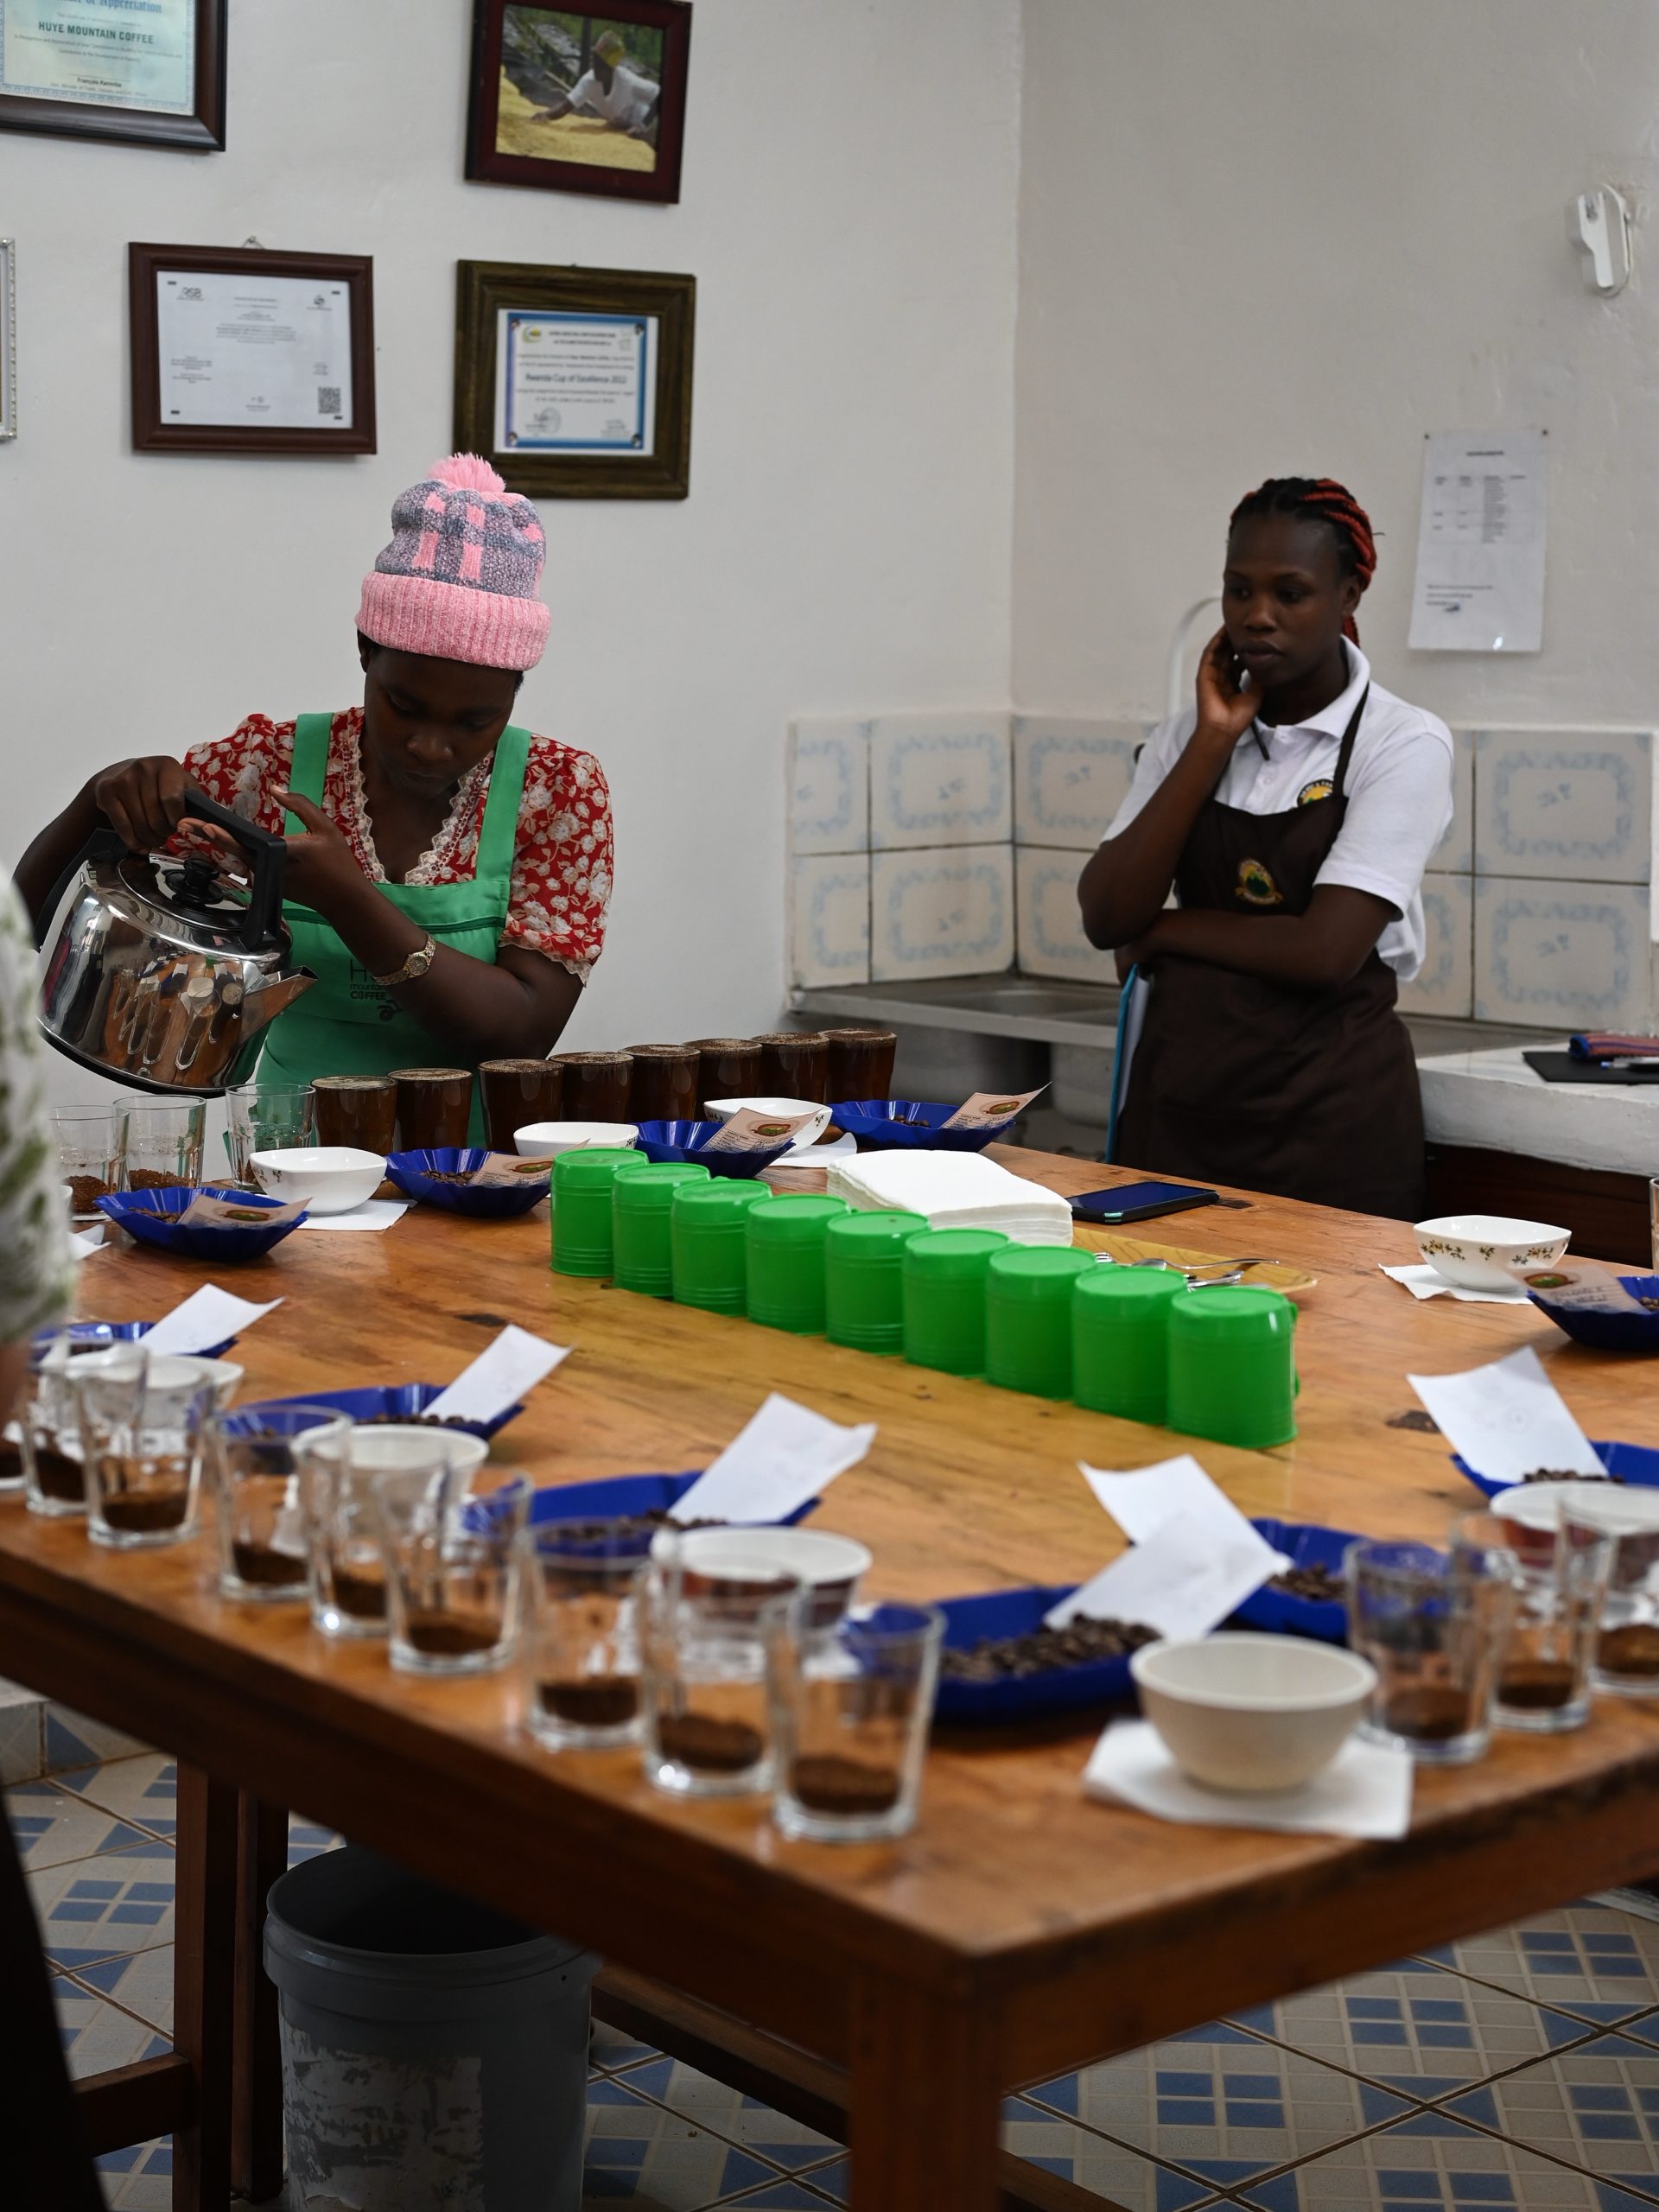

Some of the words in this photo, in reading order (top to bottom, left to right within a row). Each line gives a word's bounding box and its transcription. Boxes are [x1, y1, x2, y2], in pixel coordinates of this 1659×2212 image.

[39, 21, 64, 34] HUYE
[67, 25, 116, 40] MOUNTAIN
[119, 31, 154, 44] COFFEE
